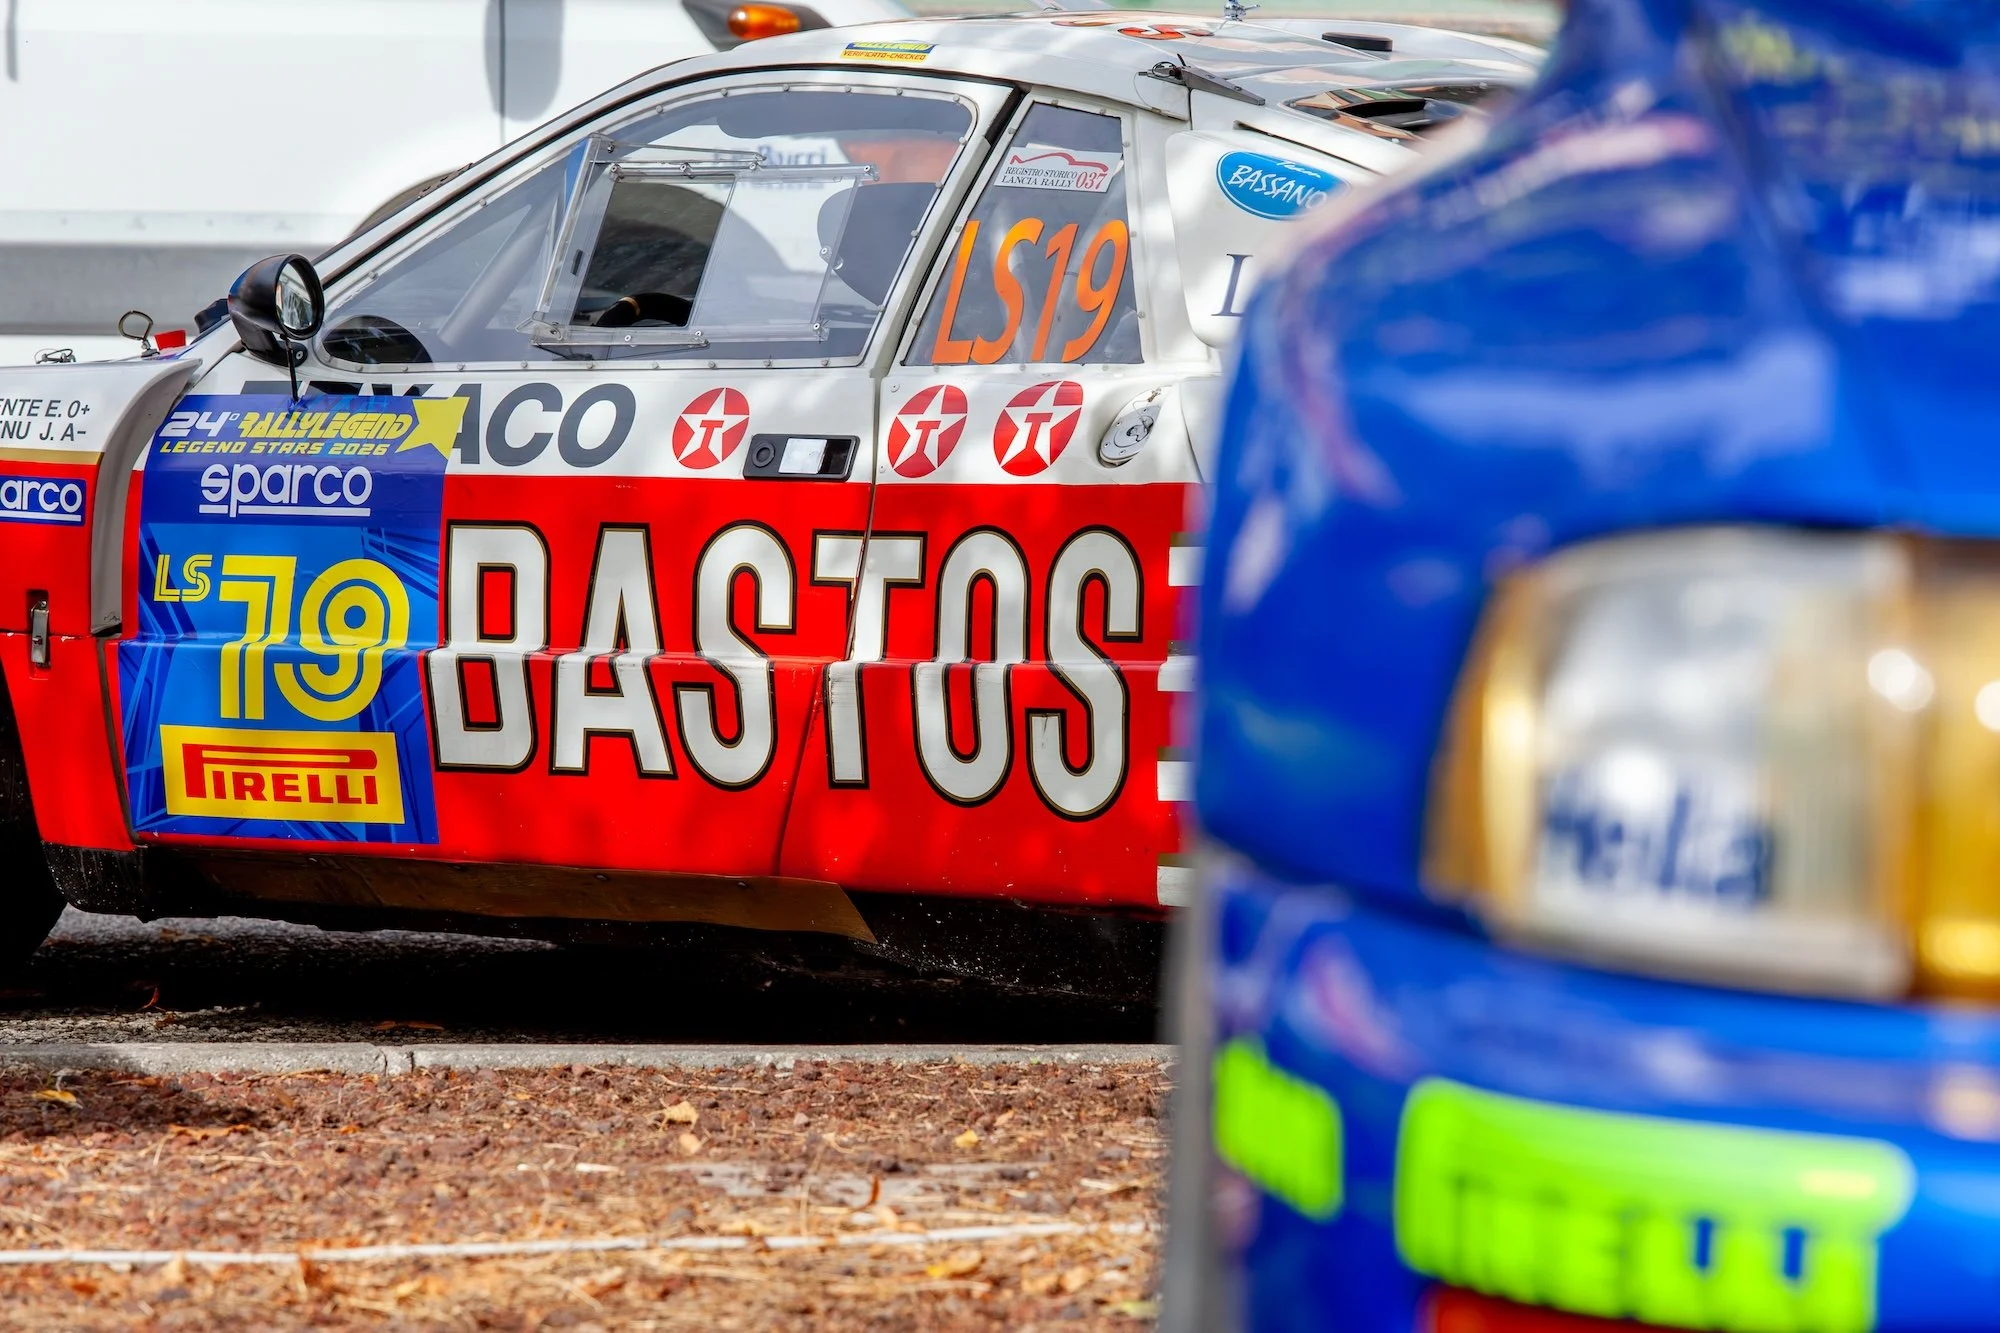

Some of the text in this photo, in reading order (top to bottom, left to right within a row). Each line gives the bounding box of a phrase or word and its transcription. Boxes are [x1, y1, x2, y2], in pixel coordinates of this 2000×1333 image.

[1001, 175, 1075, 188] LANCIA RALLY
[1005, 166, 1107, 190] REGISTRO STORICO 037
[1227, 164, 1328, 209] BASSANO
[0, 399, 43, 416] NTE
[45, 399, 62, 418] E.
[237, 411, 413, 440] RALLYLEGEND
[240, 381, 636, 468] ACO
[0, 421, 31, 440] NU
[40, 421, 54, 441] J.
[160, 440, 390, 456] LEGEND STARS 2026
[200, 463, 373, 517] sparco
[153, 553, 411, 722] LS 19
[424, 519, 1143, 822] BASTOS
[182, 743, 378, 805] PIRELLI
